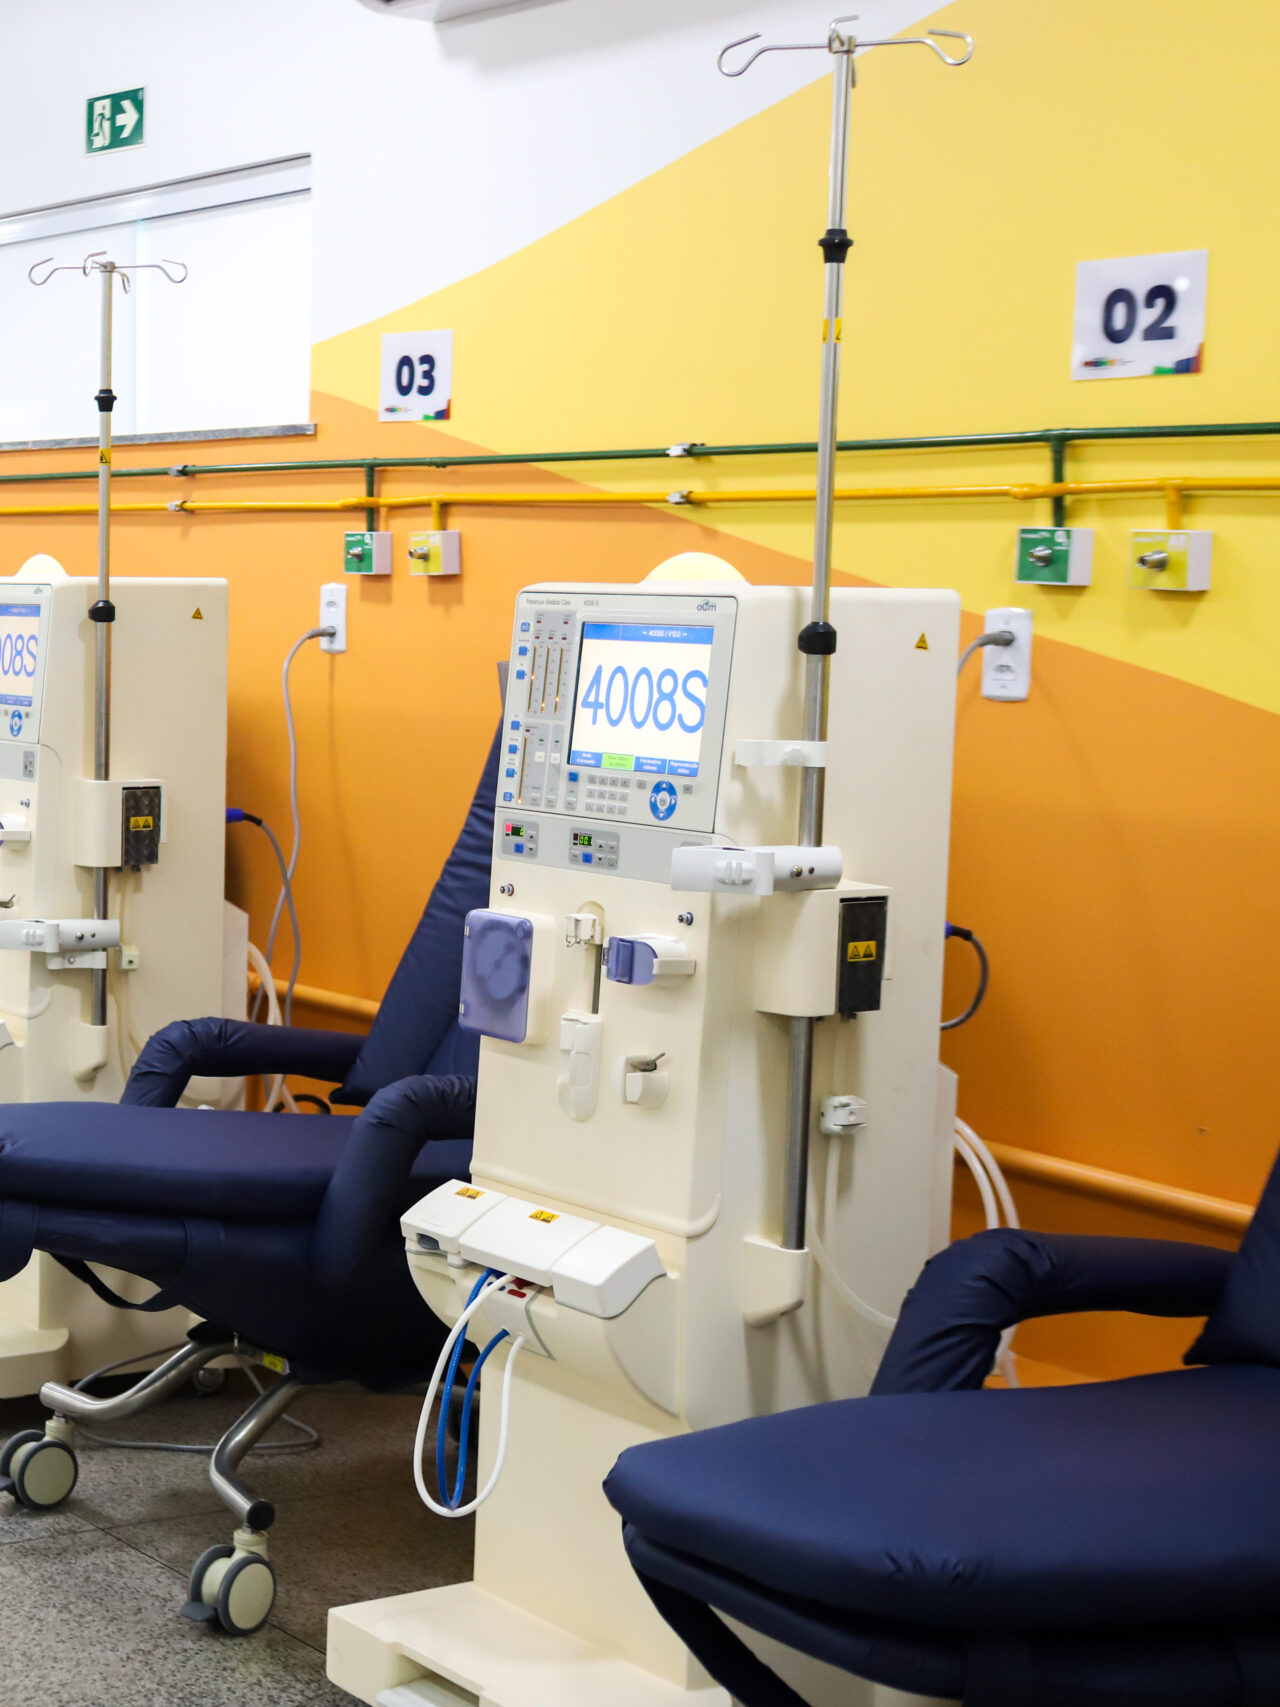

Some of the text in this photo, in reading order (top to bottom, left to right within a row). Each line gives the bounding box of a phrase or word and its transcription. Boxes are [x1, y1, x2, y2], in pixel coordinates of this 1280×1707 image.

[1102, 284, 1177, 344] 02
[395, 354, 436, 396] 03
[580, 664, 709, 734] 4008S
